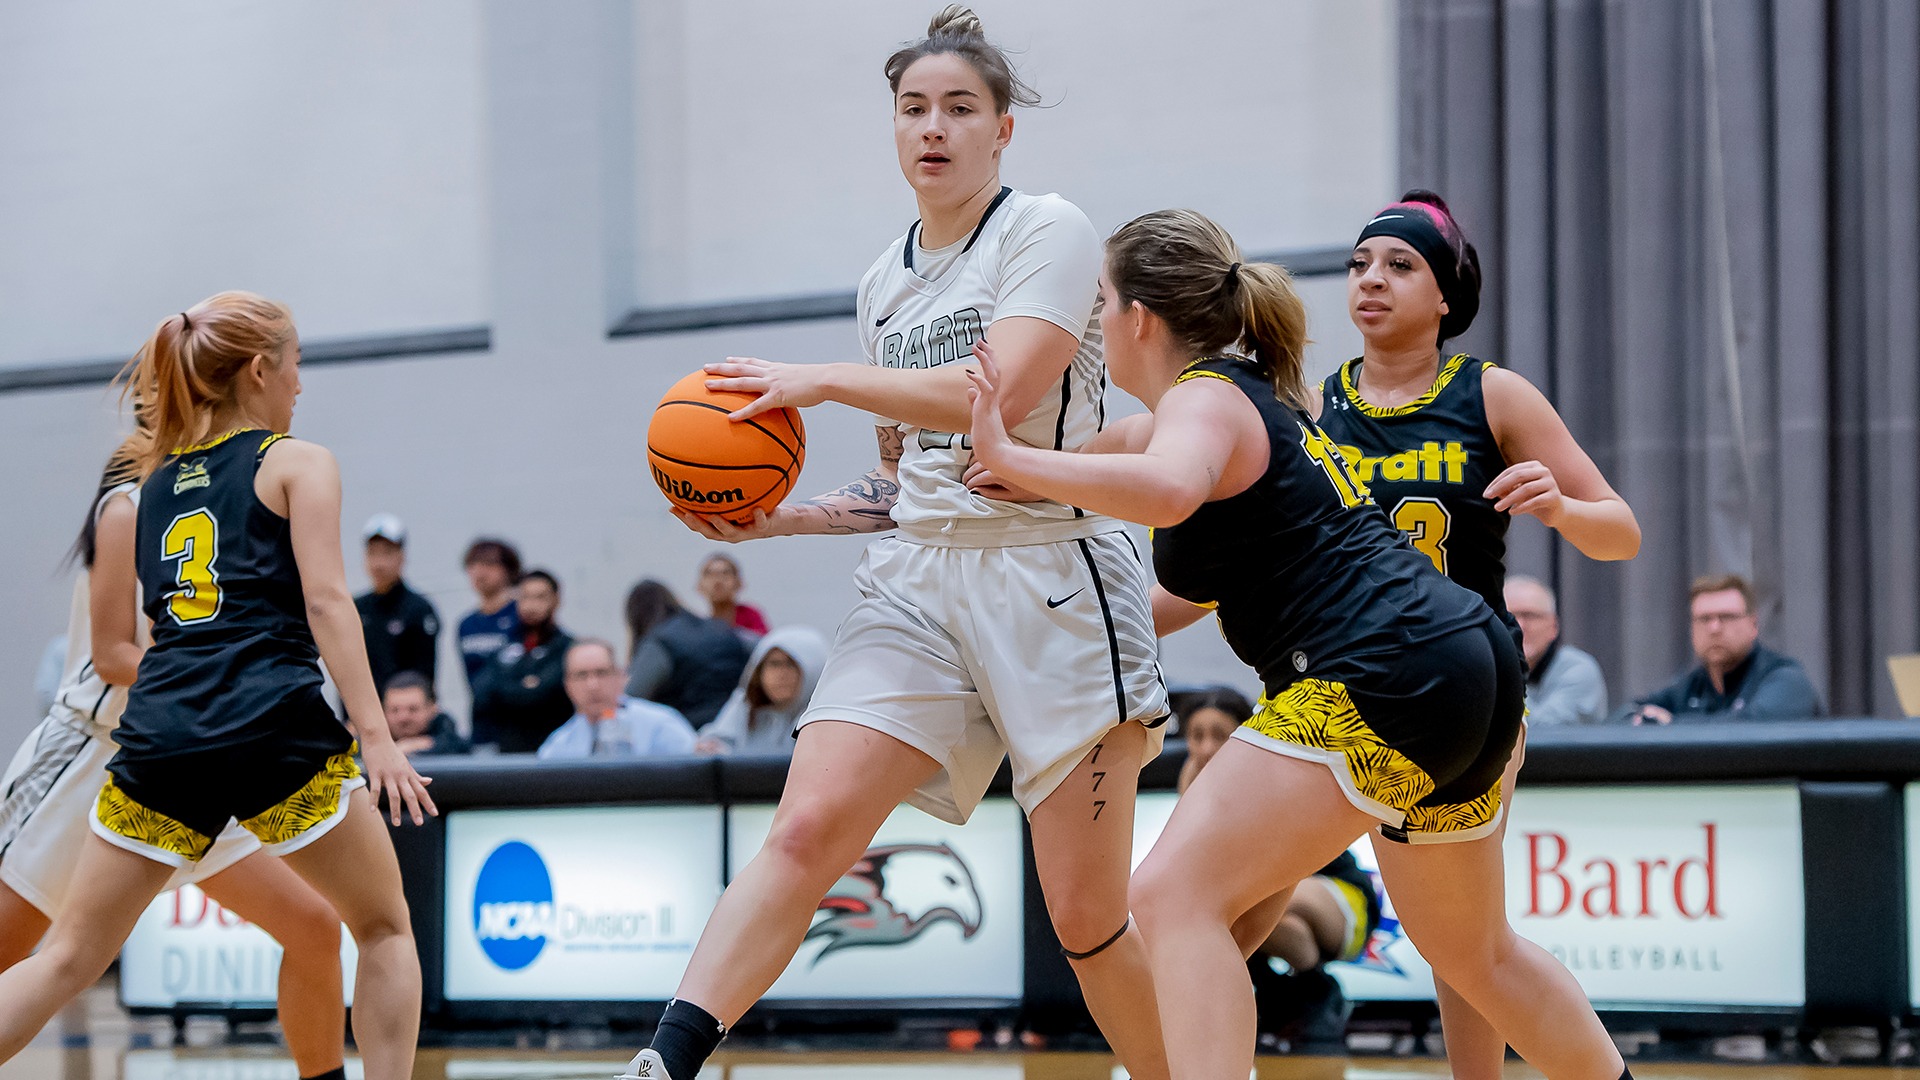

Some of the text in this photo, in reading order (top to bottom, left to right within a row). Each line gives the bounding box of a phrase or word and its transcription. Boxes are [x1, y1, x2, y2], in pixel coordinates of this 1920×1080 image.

[883, 307, 988, 369] BARD
[652, 462, 746, 504] Wilson
[161, 506, 224, 627] 3
[1523, 823, 1725, 920] Bard
[162, 946, 280, 994] DINI
[1551, 944, 1723, 972] OLLEYBALL
